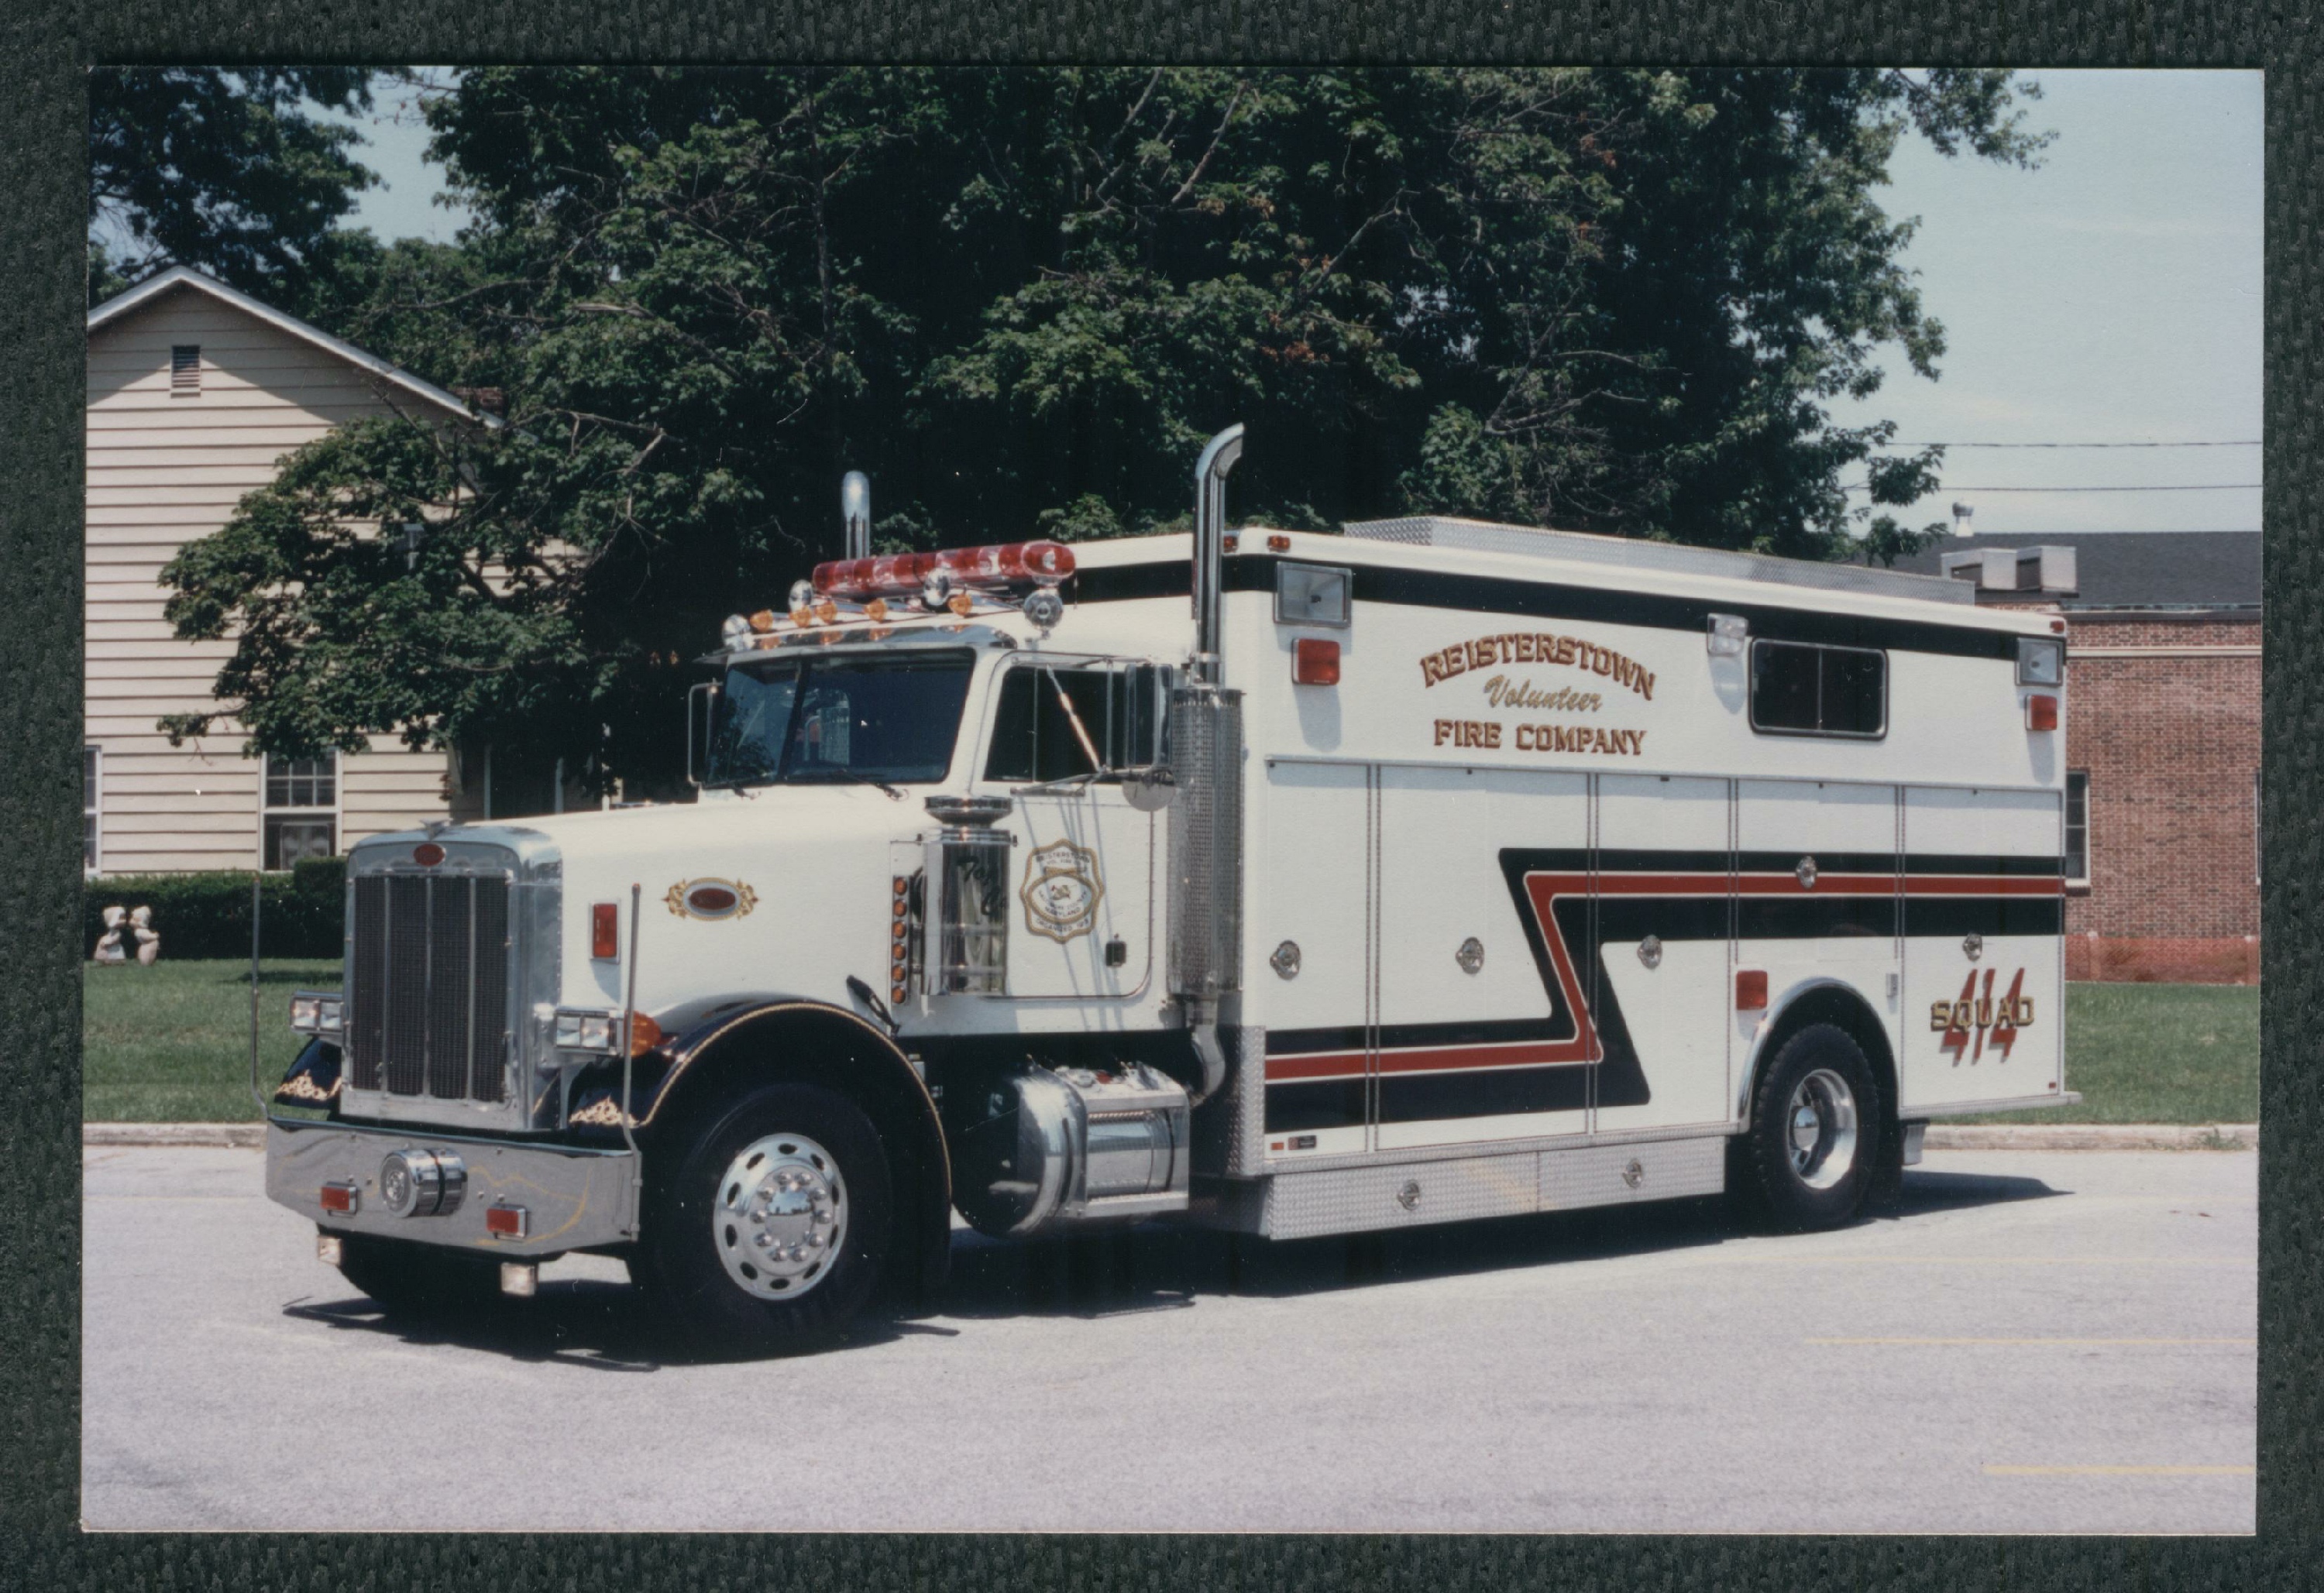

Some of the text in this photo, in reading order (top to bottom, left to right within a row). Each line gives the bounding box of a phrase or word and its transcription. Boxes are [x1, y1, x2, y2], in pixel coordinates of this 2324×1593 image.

[1419, 633, 1656, 701] REISTERSTOWN
[1483, 674, 1603, 712] Volunteer
[1434, 718, 1647, 756] FIRE COMPANY
[1930, 996, 2035, 1034] SQUAD
[1940, 966, 2025, 1067] 414
